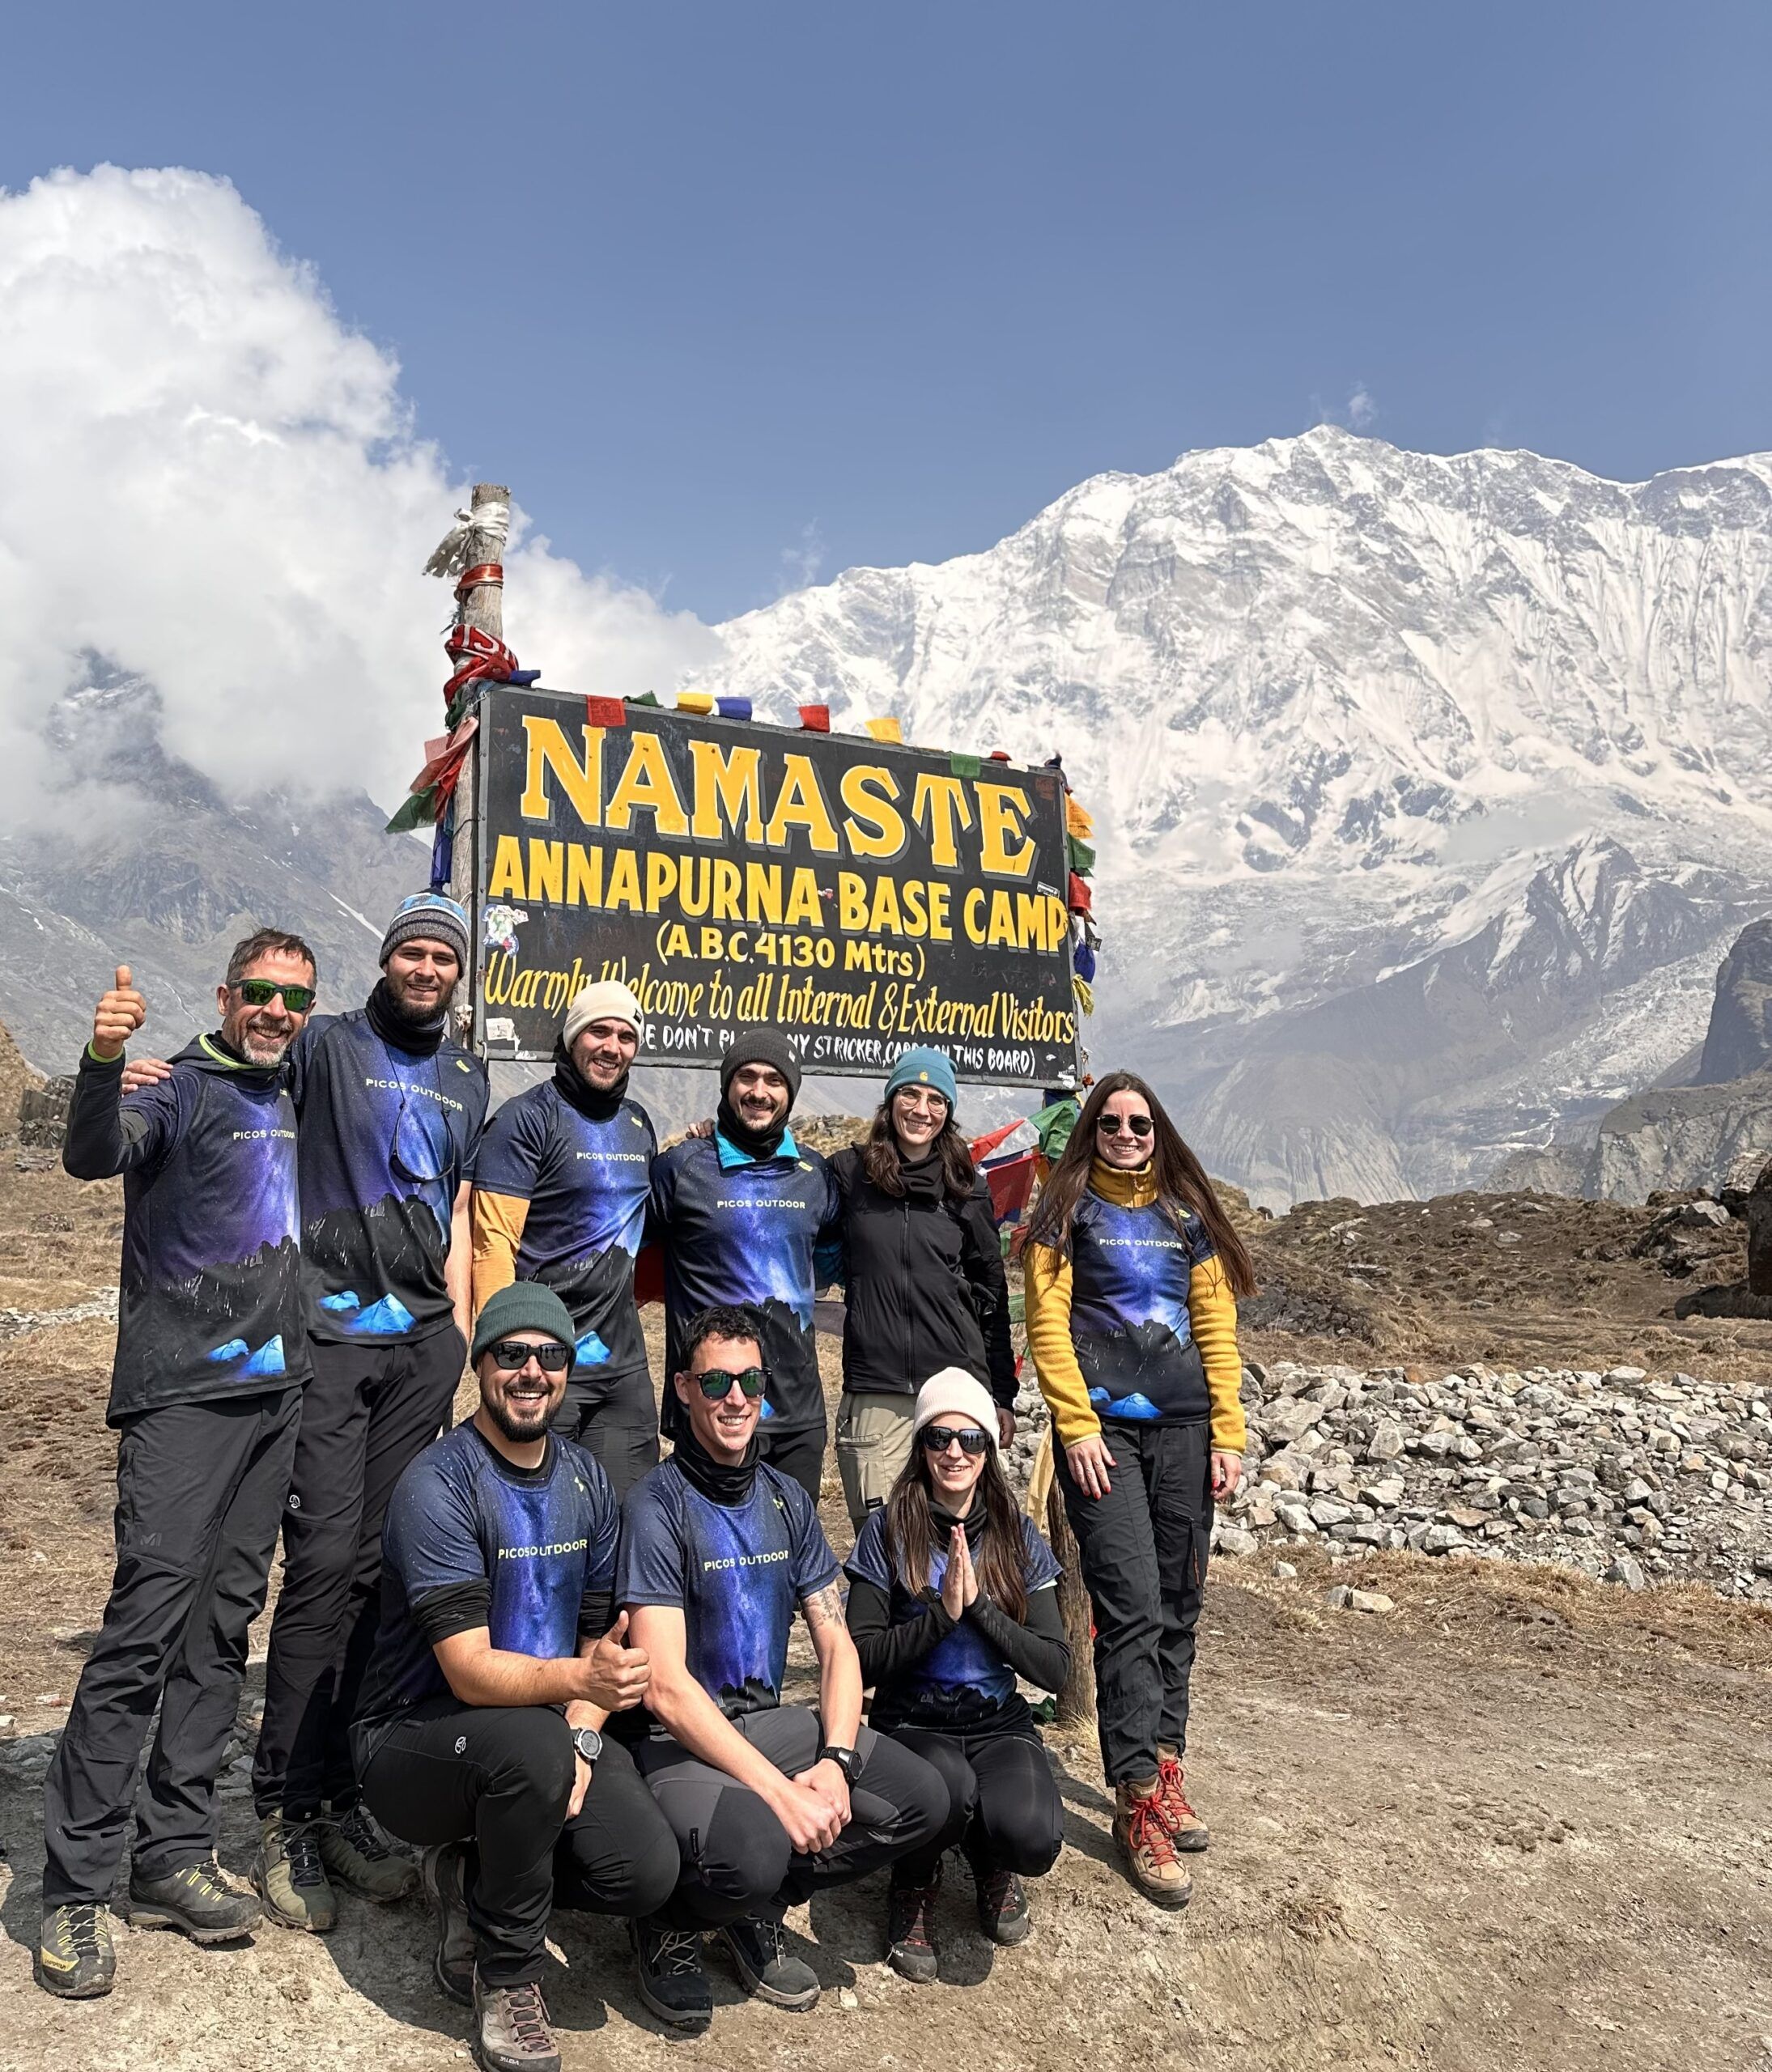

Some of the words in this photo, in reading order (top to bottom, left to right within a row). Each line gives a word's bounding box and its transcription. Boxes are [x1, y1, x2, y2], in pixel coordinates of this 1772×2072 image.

[520, 714, 1038, 878] NAMASTE
[487, 834, 824, 927] ANNAPURNA
[838, 871, 953, 941] BASE
[963, 886, 1068, 953] CAMP
[844, 940, 925, 982] Mtrs)
[709, 969, 732, 1020] to
[737, 972, 774, 1023] all
[776, 974, 878, 1030] Internal
[1001, 992, 1074, 1044] Visitors
[662, 1023, 714, 1051] DON'T
[952, 1043, 984, 1069] THIS
[987, 1047, 1037, 1077] BOARD)
[365, 1078, 406, 1091] PICOS
[410, 1084, 464, 1112] OUTDOOR
[233, 1129, 267, 1140] PICOS
[576, 1152, 603, 1161] PICOS
[606, 1153, 645, 1162] OUTDOOR
[716, 1200, 752, 1208] PICOS
[755, 1199, 805, 1209] OUTDOOR
[1134, 1239, 1183, 1250] OUTDOOR
[703, 1557, 736, 1572] PICOS
